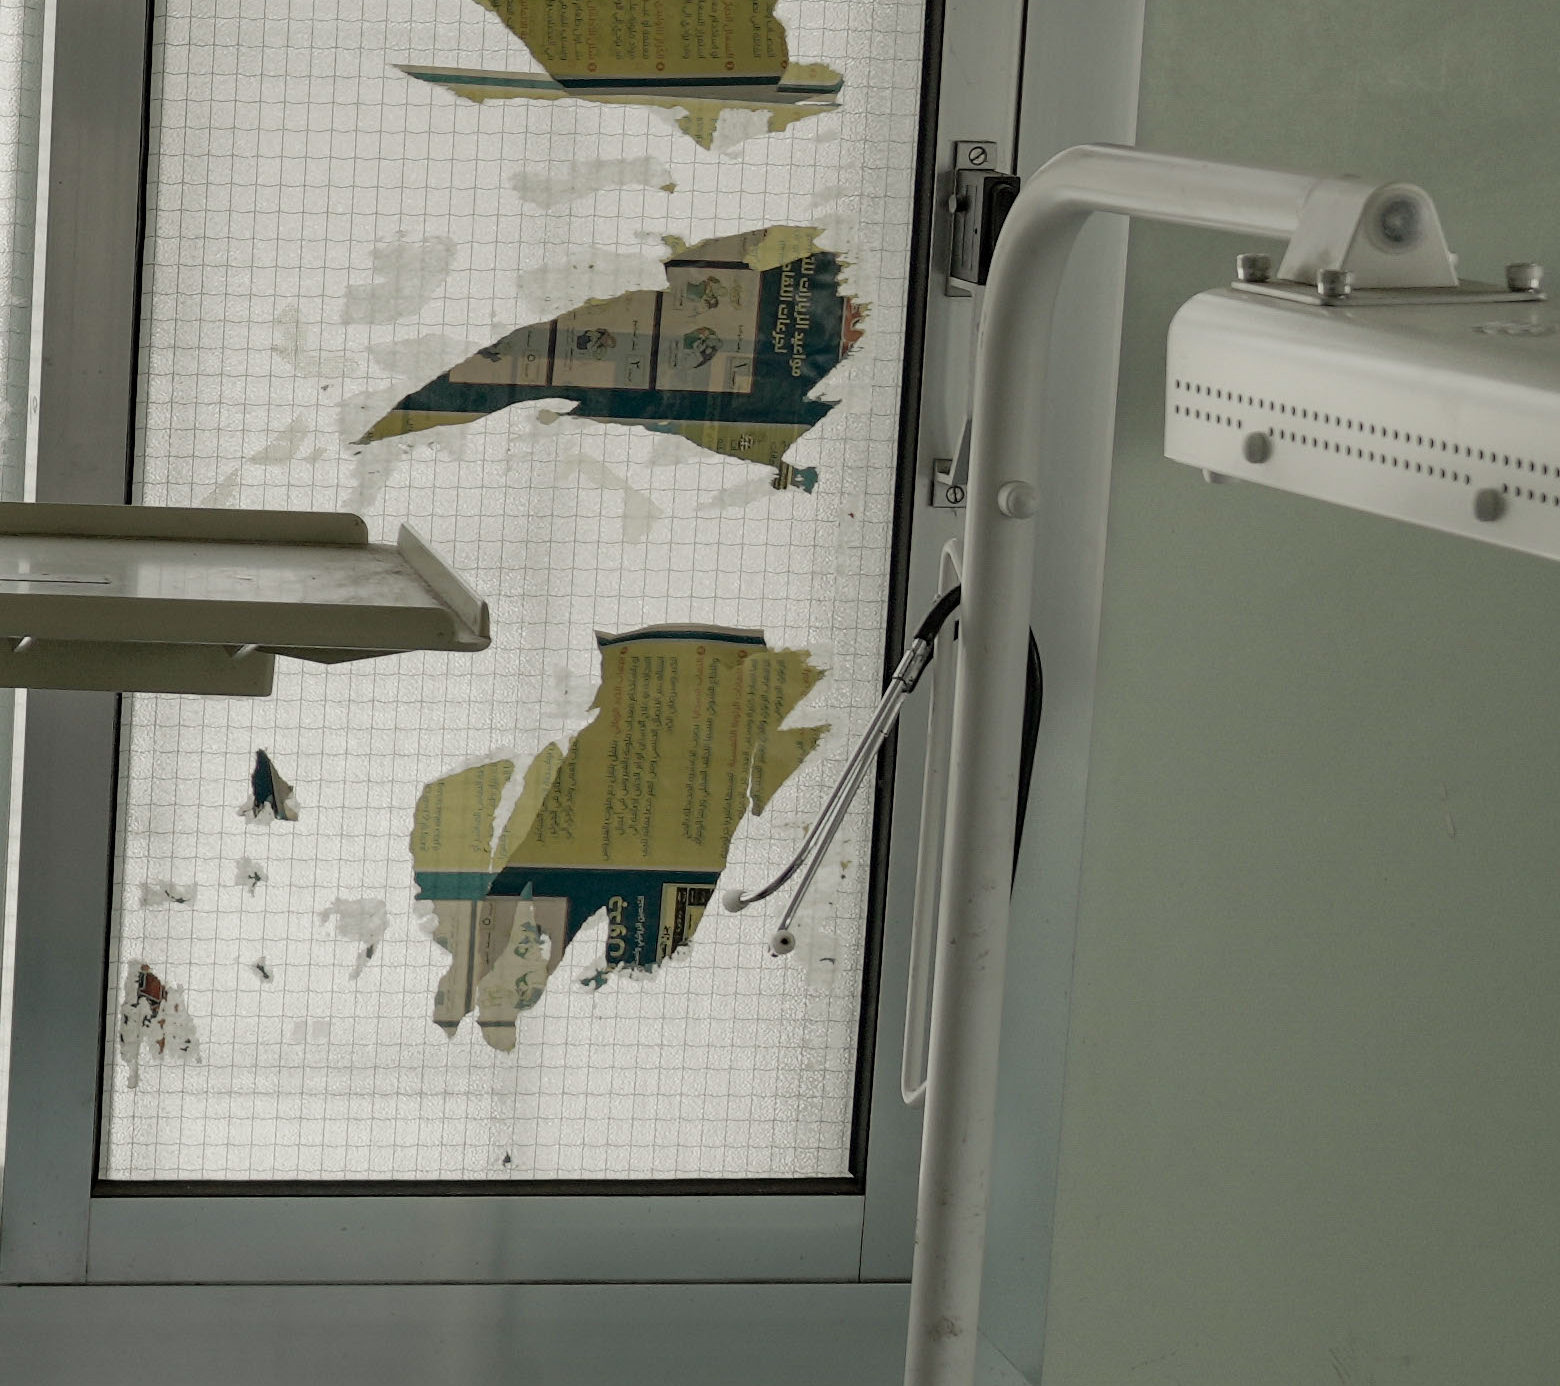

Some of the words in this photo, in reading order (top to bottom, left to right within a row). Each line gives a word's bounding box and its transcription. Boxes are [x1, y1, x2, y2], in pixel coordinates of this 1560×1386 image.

[794, 277, 811, 329] الزيارات
[771, 304, 792, 354] لجرعات
[789, 331, 806, 377] مواعيد
